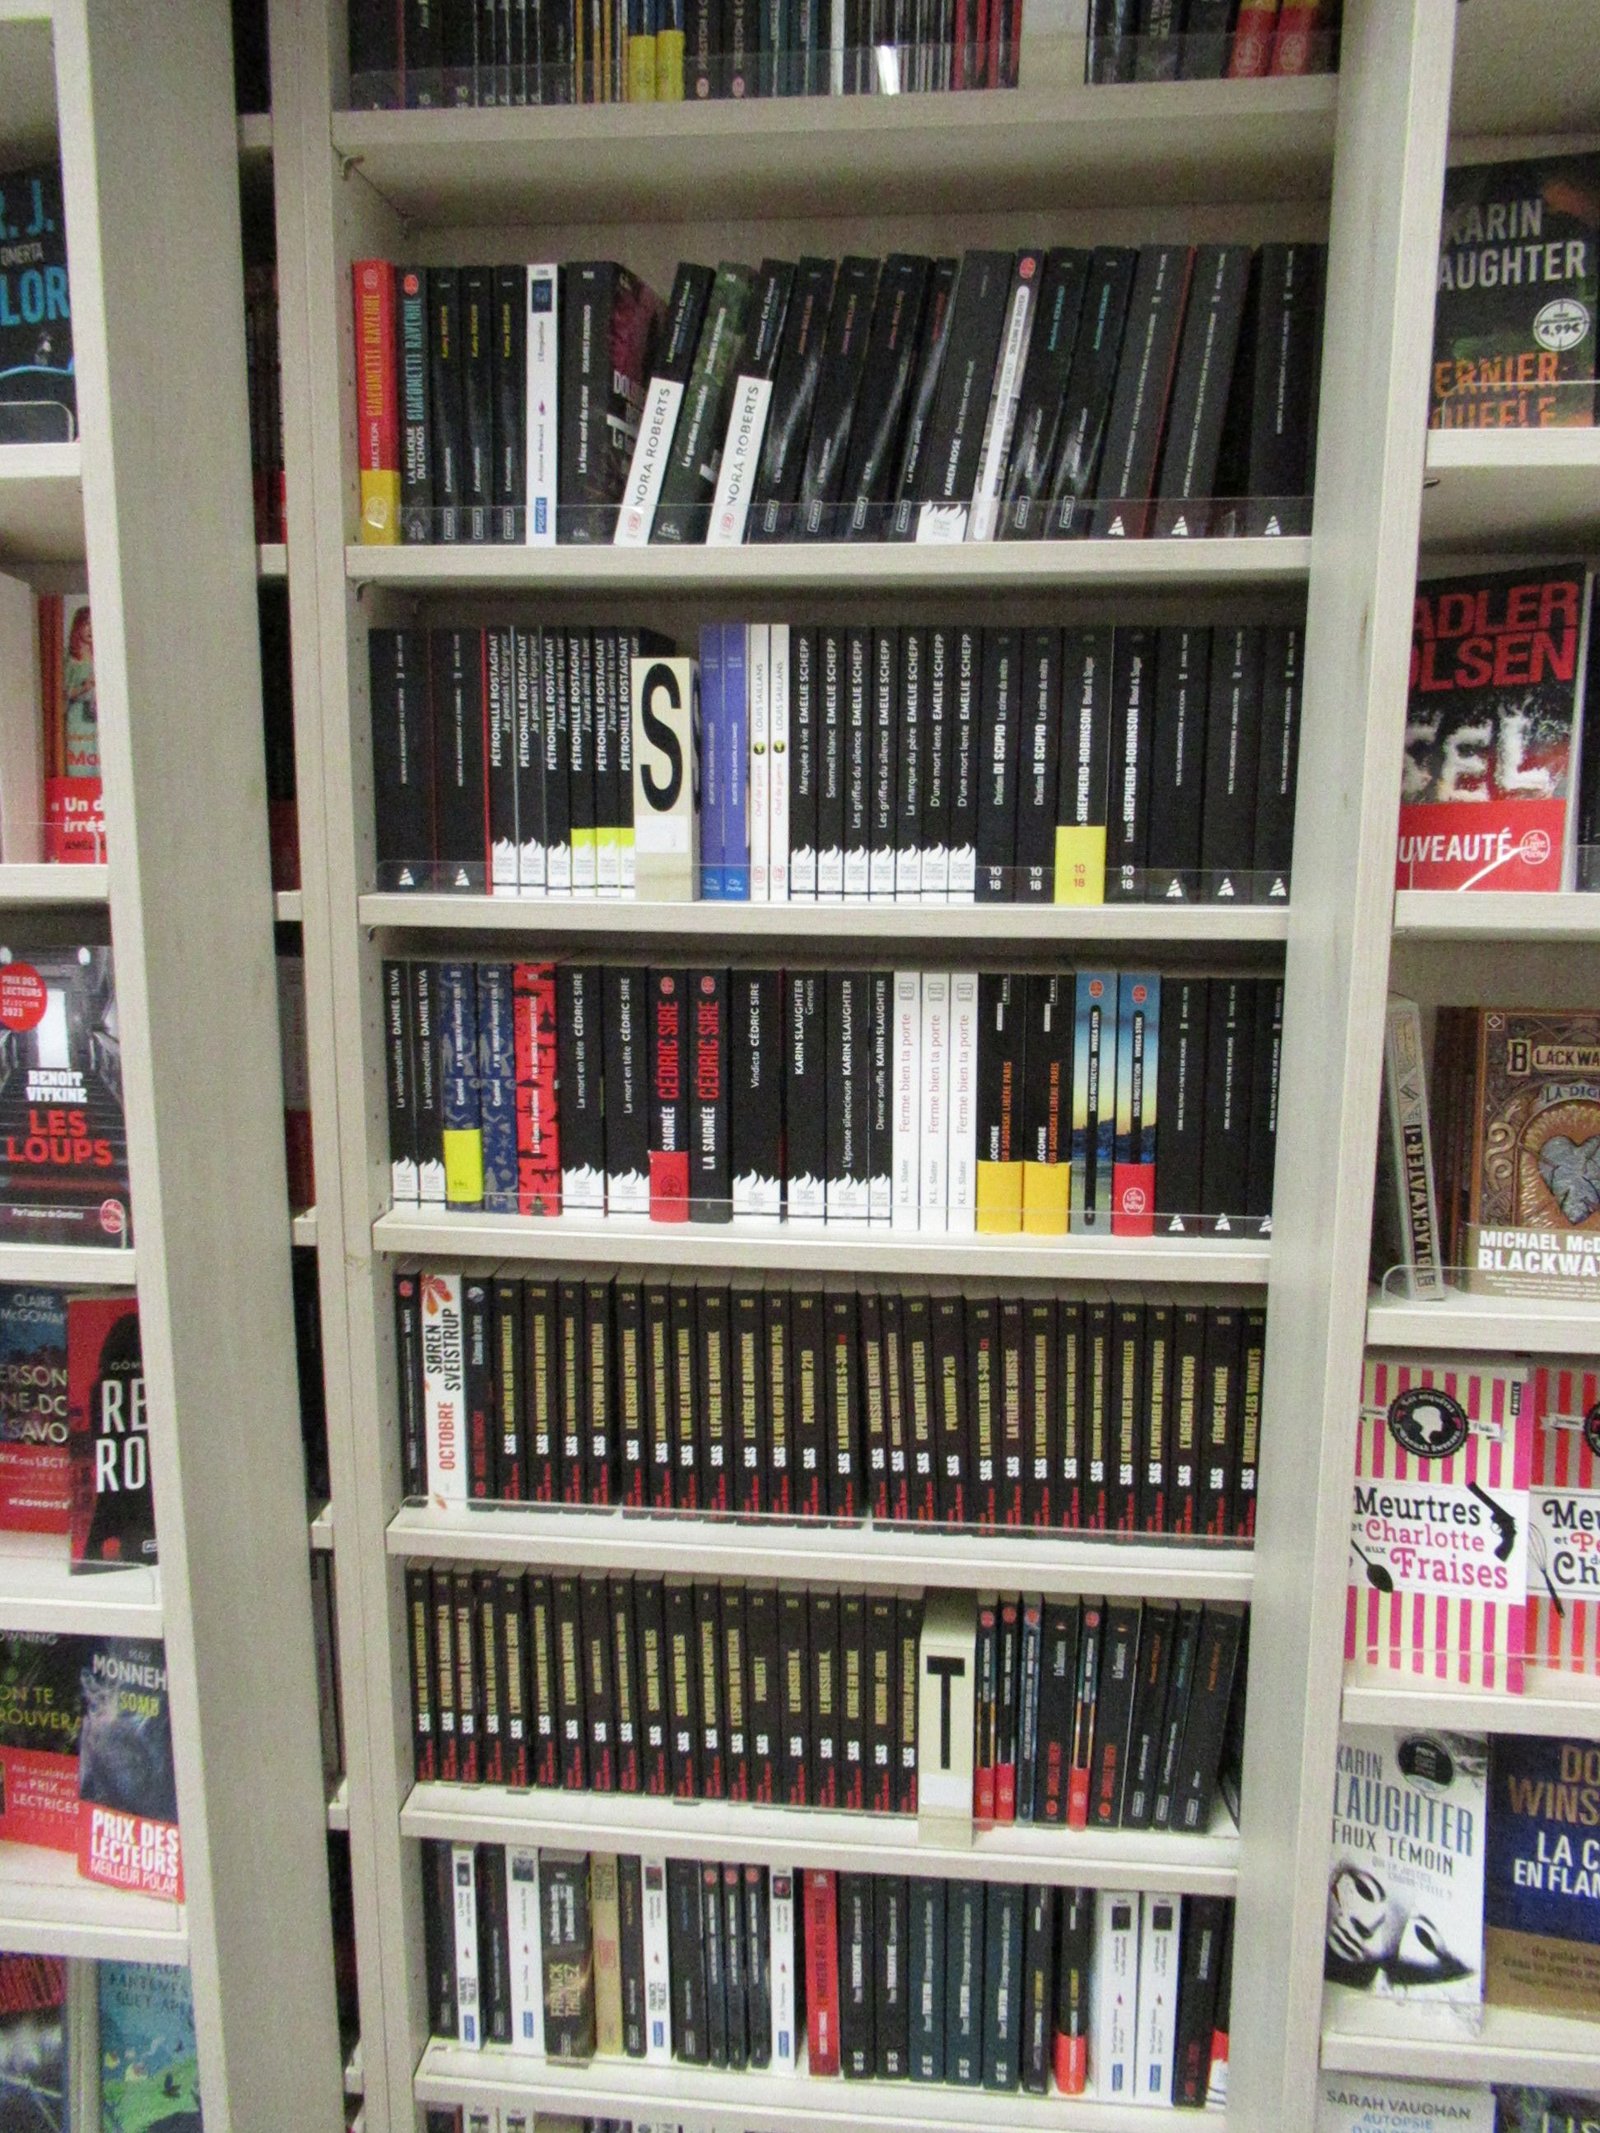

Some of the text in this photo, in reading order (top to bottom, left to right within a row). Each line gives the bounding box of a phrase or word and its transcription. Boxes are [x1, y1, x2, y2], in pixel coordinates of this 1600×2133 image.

[1445, 199, 1543, 246] KARIN
[407, 427, 417, 484] LA RELIQUE
[416, 426, 425, 479] DU CHAOS
[634, 388, 671, 506] NORA ROBERTS
[726, 386, 759, 506] NORA ROBERTS
[943, 439, 961, 496] KAREN ROSE
[556, 638, 564, 658] tuer
[557, 660, 564, 669] te
[489, 634, 501, 767] PÉTRONILLE ROSTAGNAT
[501, 685, 511, 719] pensais
[556, 671, 565, 695] aimé
[545, 638, 556, 770] PÉTRONILLE ROSTAGNAT
[826, 639, 836, 798] Sommeil blanc EMELIE SCHEPP
[931, 634, 944, 807] D'une mort lente EMELIE SCHEPP
[501, 721, 511, 733] Je
[640, 663, 683, 812] S
[879, 640, 890, 828] Les griffes du silence EMELIE SCHEPP
[994, 724, 1006, 774] DI SCIPIO
[1123, 709, 1139, 821] SHEPHERD-ROBINSON
[63, 797, 88, 812] Un
[989, 866, 1001, 876] 10
[989, 880, 1001, 890] 18
[2, 986, 42, 997] LECTEURS
[805, 980, 814, 1015] Genesis
[390, 968, 405, 1108] La violoncelliste DANIEL SILVA
[572, 974, 585, 1108] La mort en tête CÉDRIC SIRE
[748, 983, 760, 1088] Vindicta CÉDRIC SIRE
[794, 980, 804, 1074] KARIN SLAUGHTER
[28, 1067, 83, 1087] BENOÎT
[695, 1001, 719, 1169] LA SAIGNÉE CÉDRIC SIRE
[899, 1014, 913, 1133] Ferme bien ta porte
[26, 1087, 88, 1103] VITKINE
[29, 1109, 87, 1137] LES
[7, 1135, 113, 1167] LOUPS
[1480, 1230, 1560, 1251] MICHAEL
[13, 1293, 55, 1309] CLAIRE
[425, 1325, 442, 1374] SØREN
[442, 1309, 461, 1391] SVEISTRUP
[943, 1356, 960, 1476] SAS POLONIUM 210
[438, 1402, 455, 1470] OCTOBRE
[96, 1436, 146, 1493] RO
[711, 1445, 723, 1466] SAS
[1178, 1465, 1191, 1486] SAS
[1354, 1486, 1480, 1525] Meurtres
[1365, 1520, 1485, 1552] Charlotte
[1365, 1544, 1386, 1555] aux
[1554, 1535, 1568, 1546] et
[1390, 1547, 1508, 1590] Fraises
[33, 1687, 54, 1705] TE
[927, 1655, 965, 1770] T
[756, 1735, 768, 1754] SAS
[847, 1741, 859, 1760] SAS
[1336, 1745, 1384, 1781] KARIN
[13, 1793, 79, 1814] LECTRICES
[29, 1780, 59, 1796] PRIX
[91, 1808, 179, 1855] PRIX DES
[1332, 1818, 1377, 1853] FAUX
[1388, 1831, 1454, 1878] TÉMOIN
[1537, 1830, 1573, 1868] LA
[91, 1835, 178, 1878] LECTEURS
[1513, 1858, 1543, 1889] EN
[91, 1858, 178, 1896] MEILLEUR POLAR
[1327, 2090, 1471, 2121] SARAH VAUGHAN
[1363, 2114, 1432, 2130] AUTOPSIE
